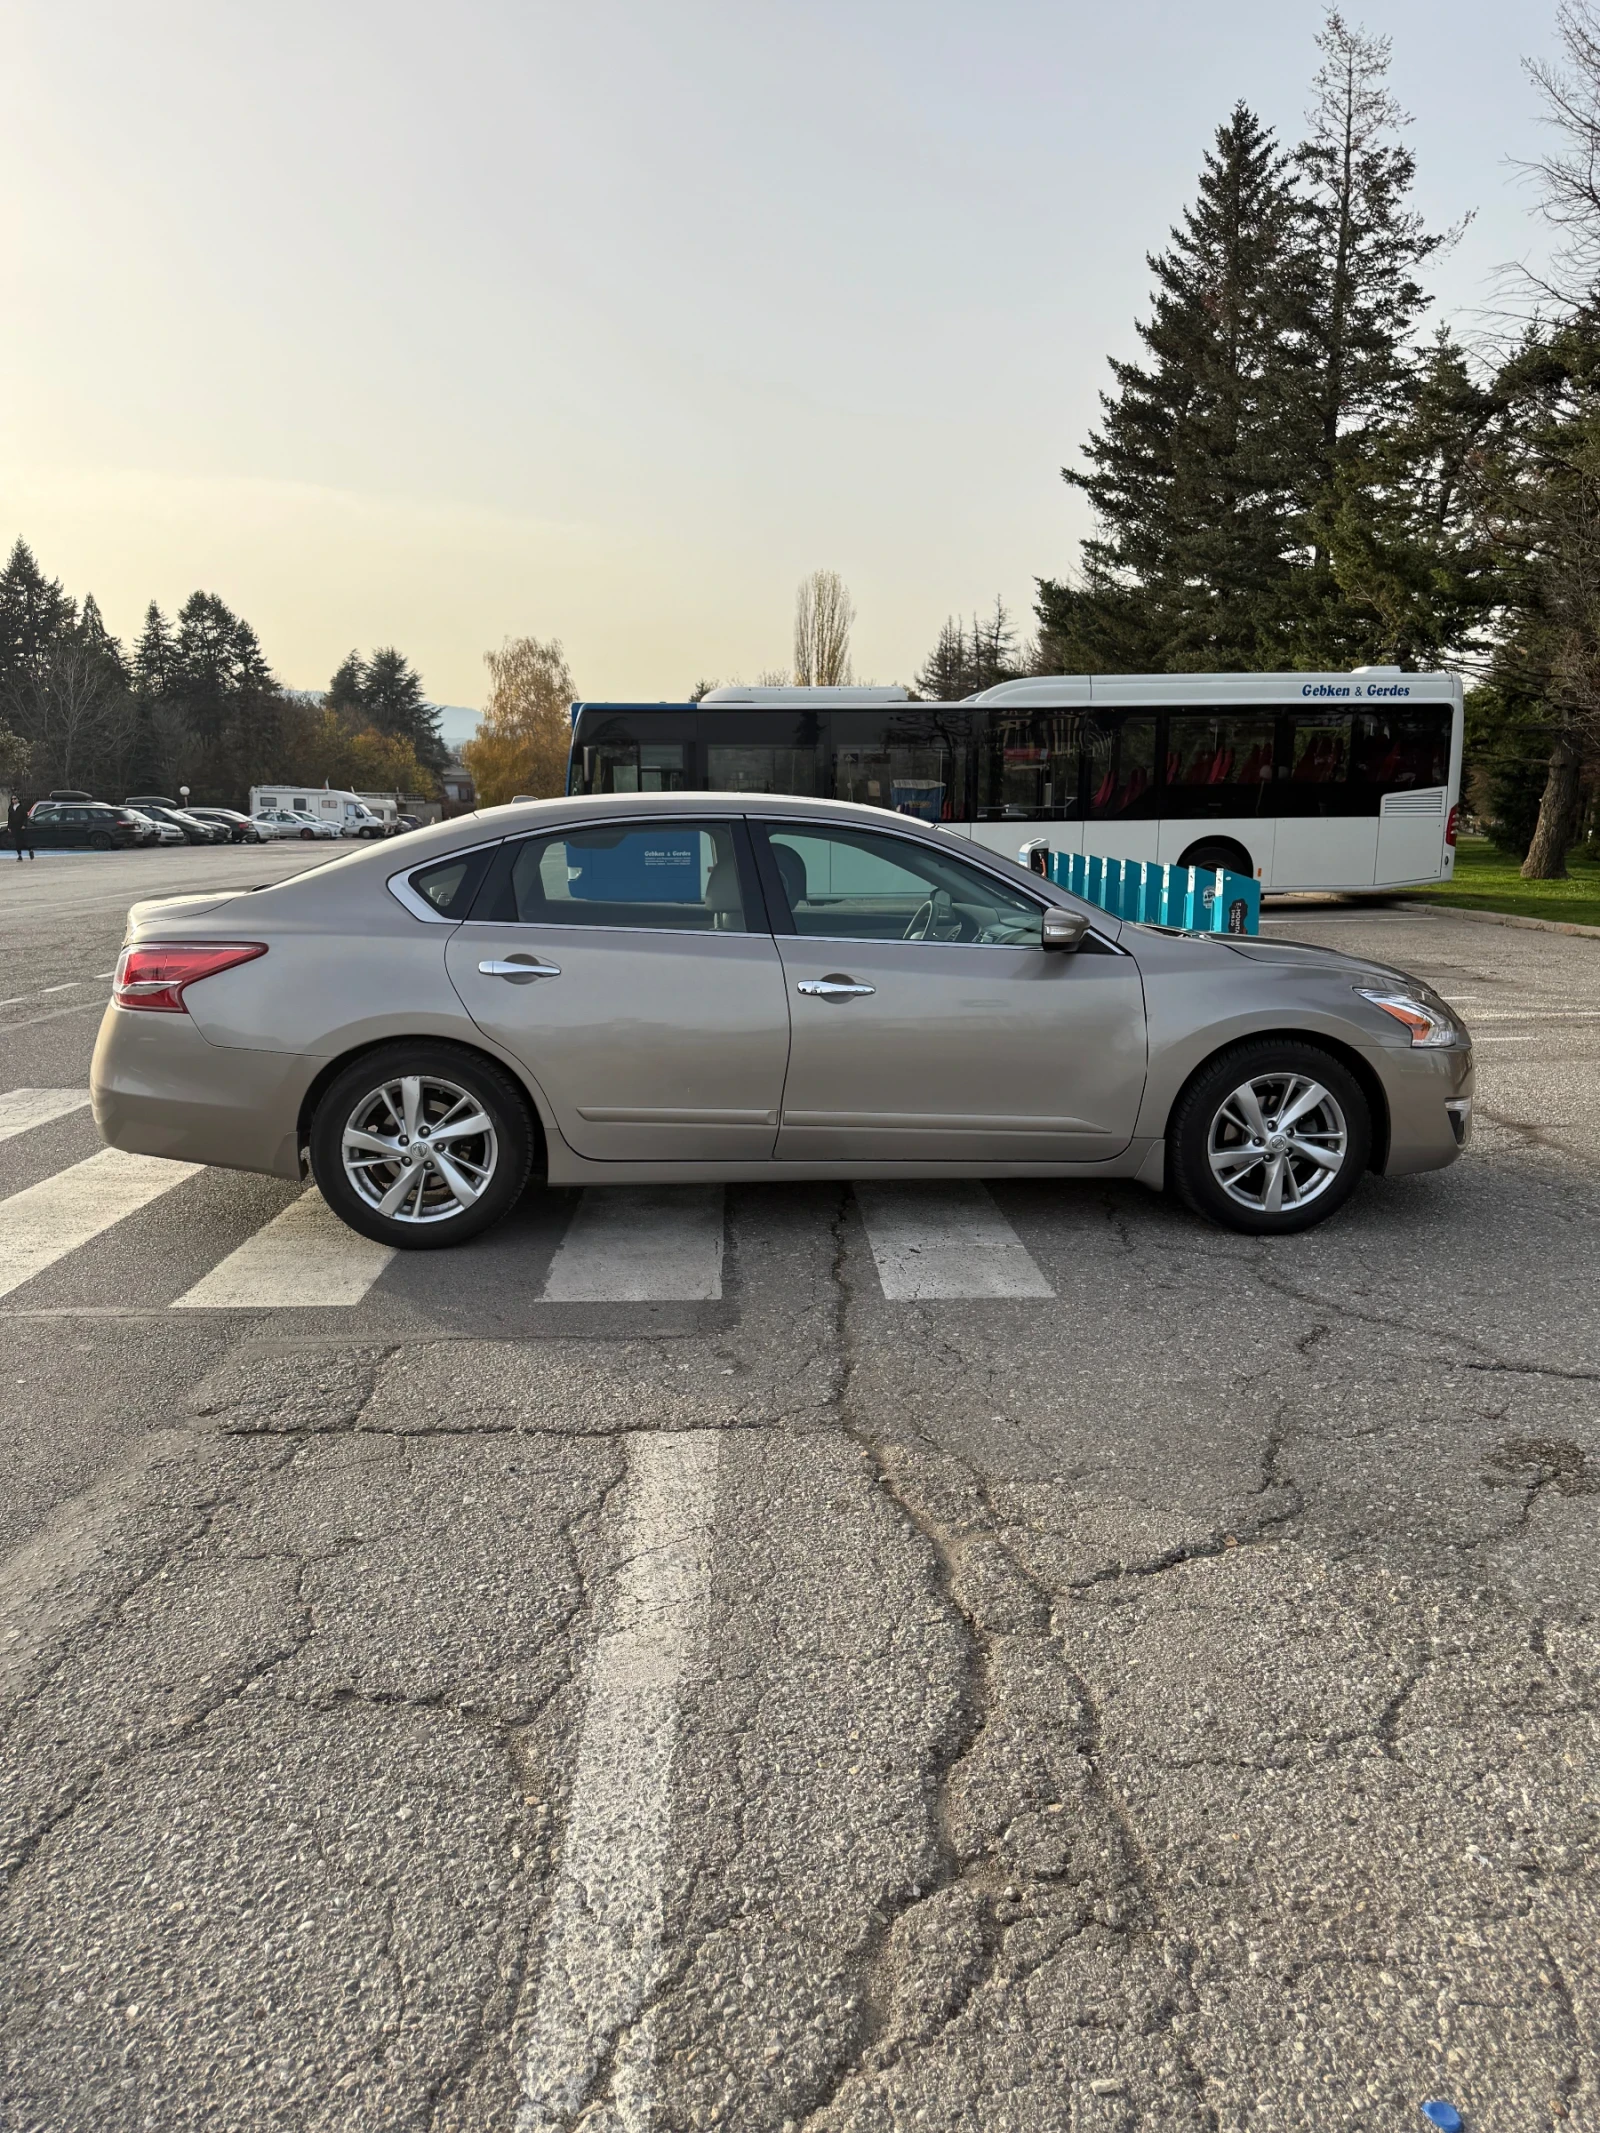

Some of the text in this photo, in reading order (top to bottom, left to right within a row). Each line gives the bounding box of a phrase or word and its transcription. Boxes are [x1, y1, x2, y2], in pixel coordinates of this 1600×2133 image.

[1302, 684, 1410, 697] Gebken & Gerdes
